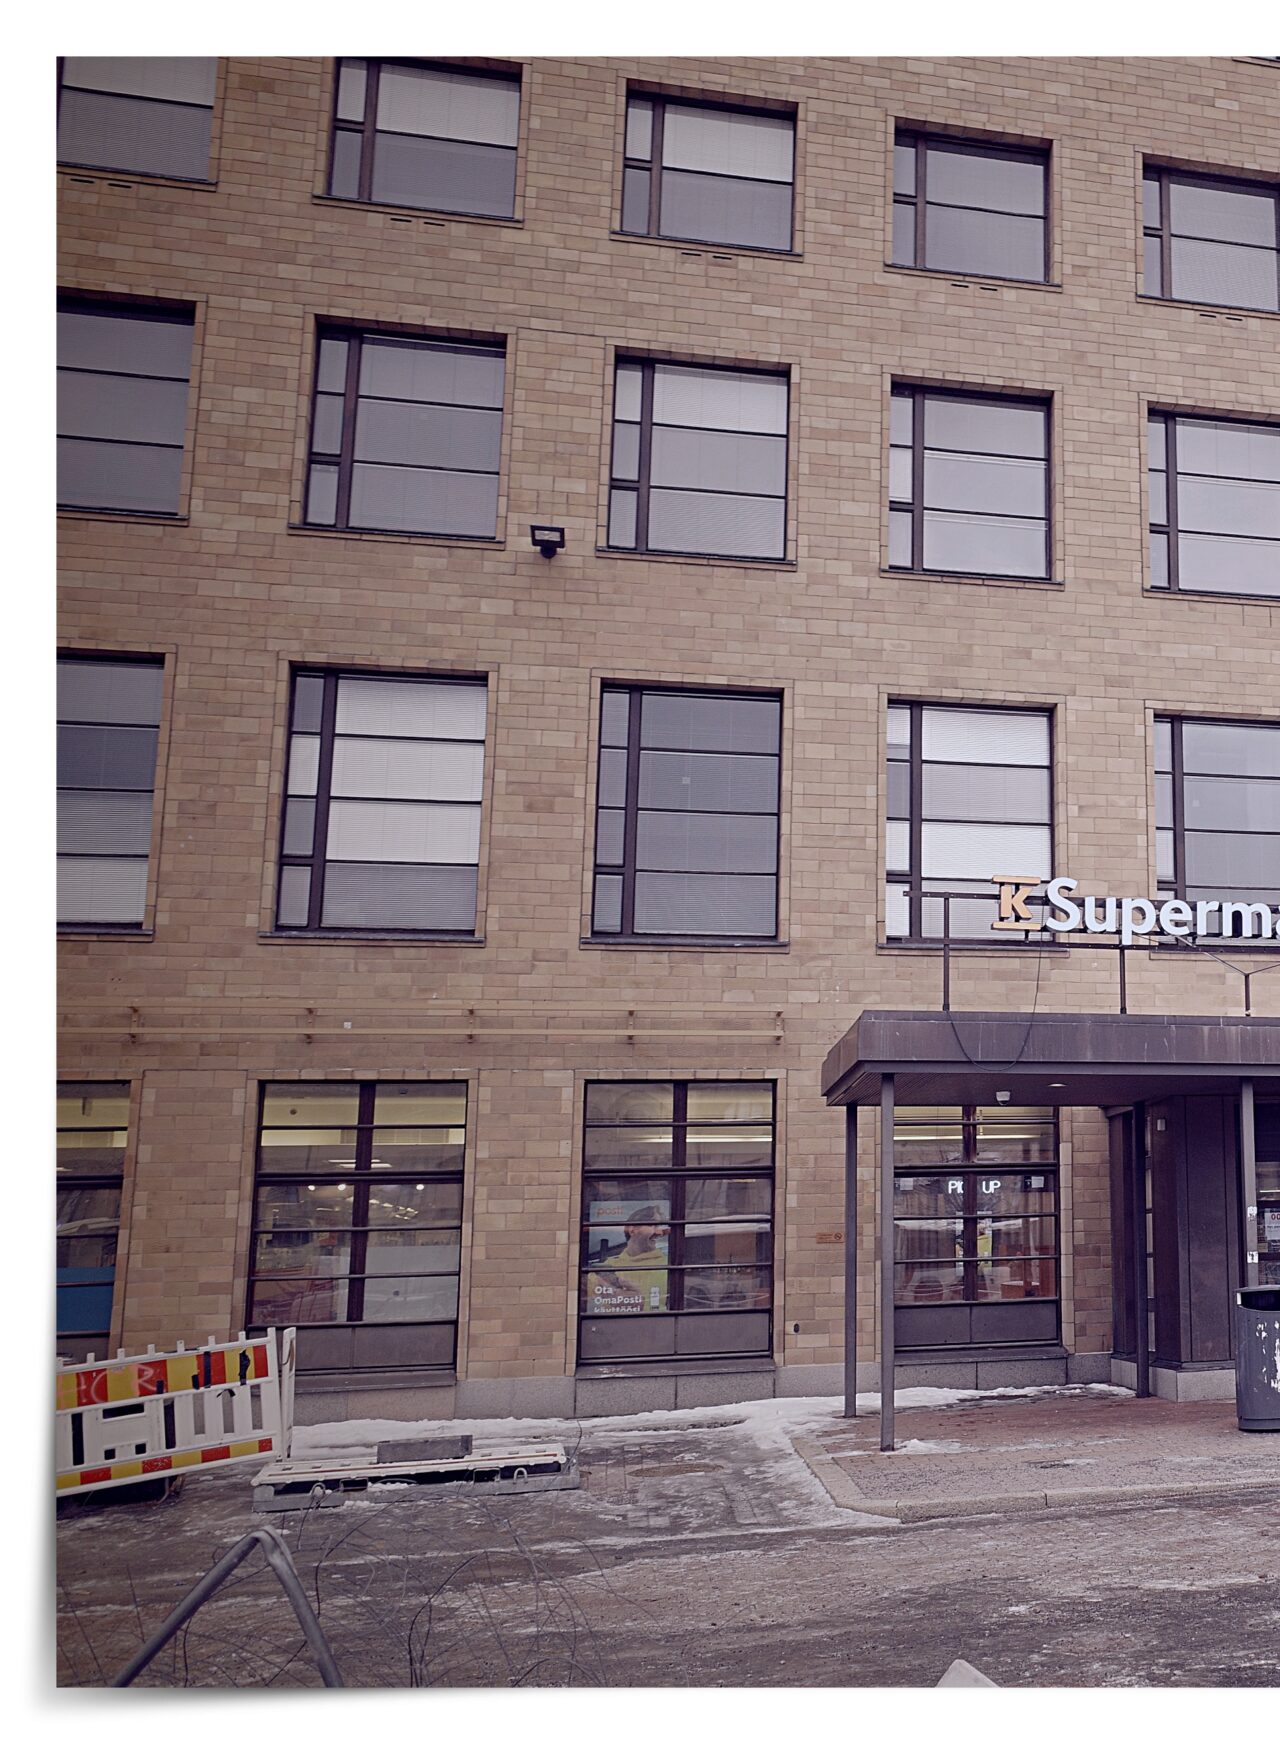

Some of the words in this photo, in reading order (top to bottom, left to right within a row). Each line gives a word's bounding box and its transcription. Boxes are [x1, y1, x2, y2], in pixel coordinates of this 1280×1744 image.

[982, 1180, 1001, 1194] UP
[594, 1286, 613, 1294] Ota
[594, 1295, 642, 1305] OmaPosti
